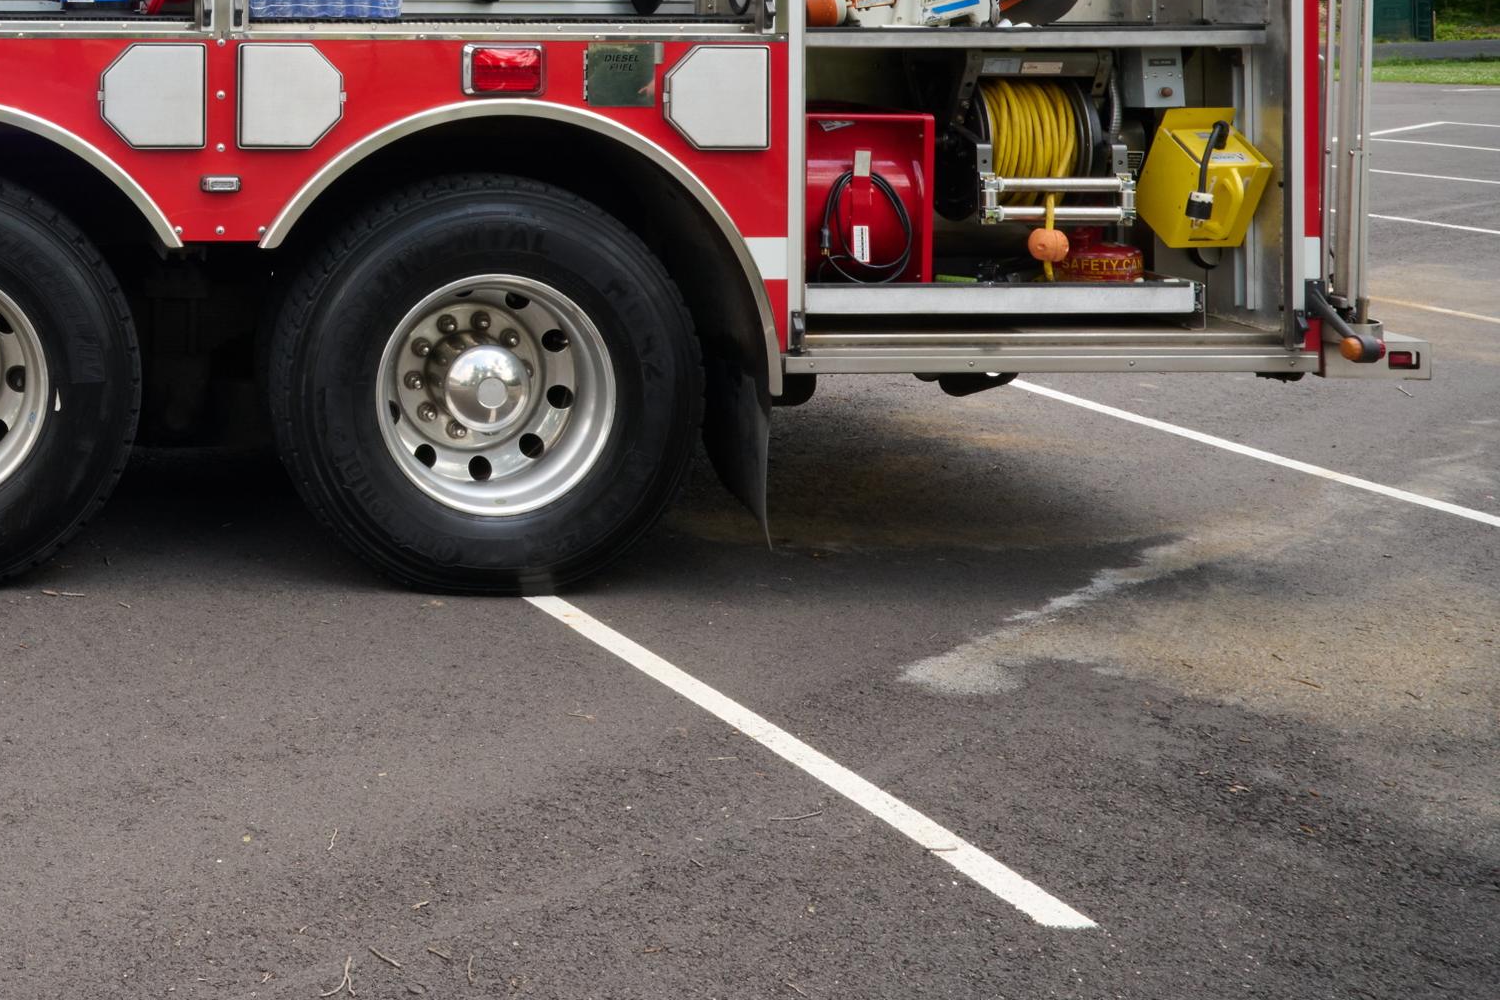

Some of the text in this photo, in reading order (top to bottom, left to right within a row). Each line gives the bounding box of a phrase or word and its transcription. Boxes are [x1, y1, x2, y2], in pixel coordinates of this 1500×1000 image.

[604, 54, 640, 63] DIESEL
[609, 63, 634, 72] FUEL
[1061, 258, 1119, 272] SAFETY
